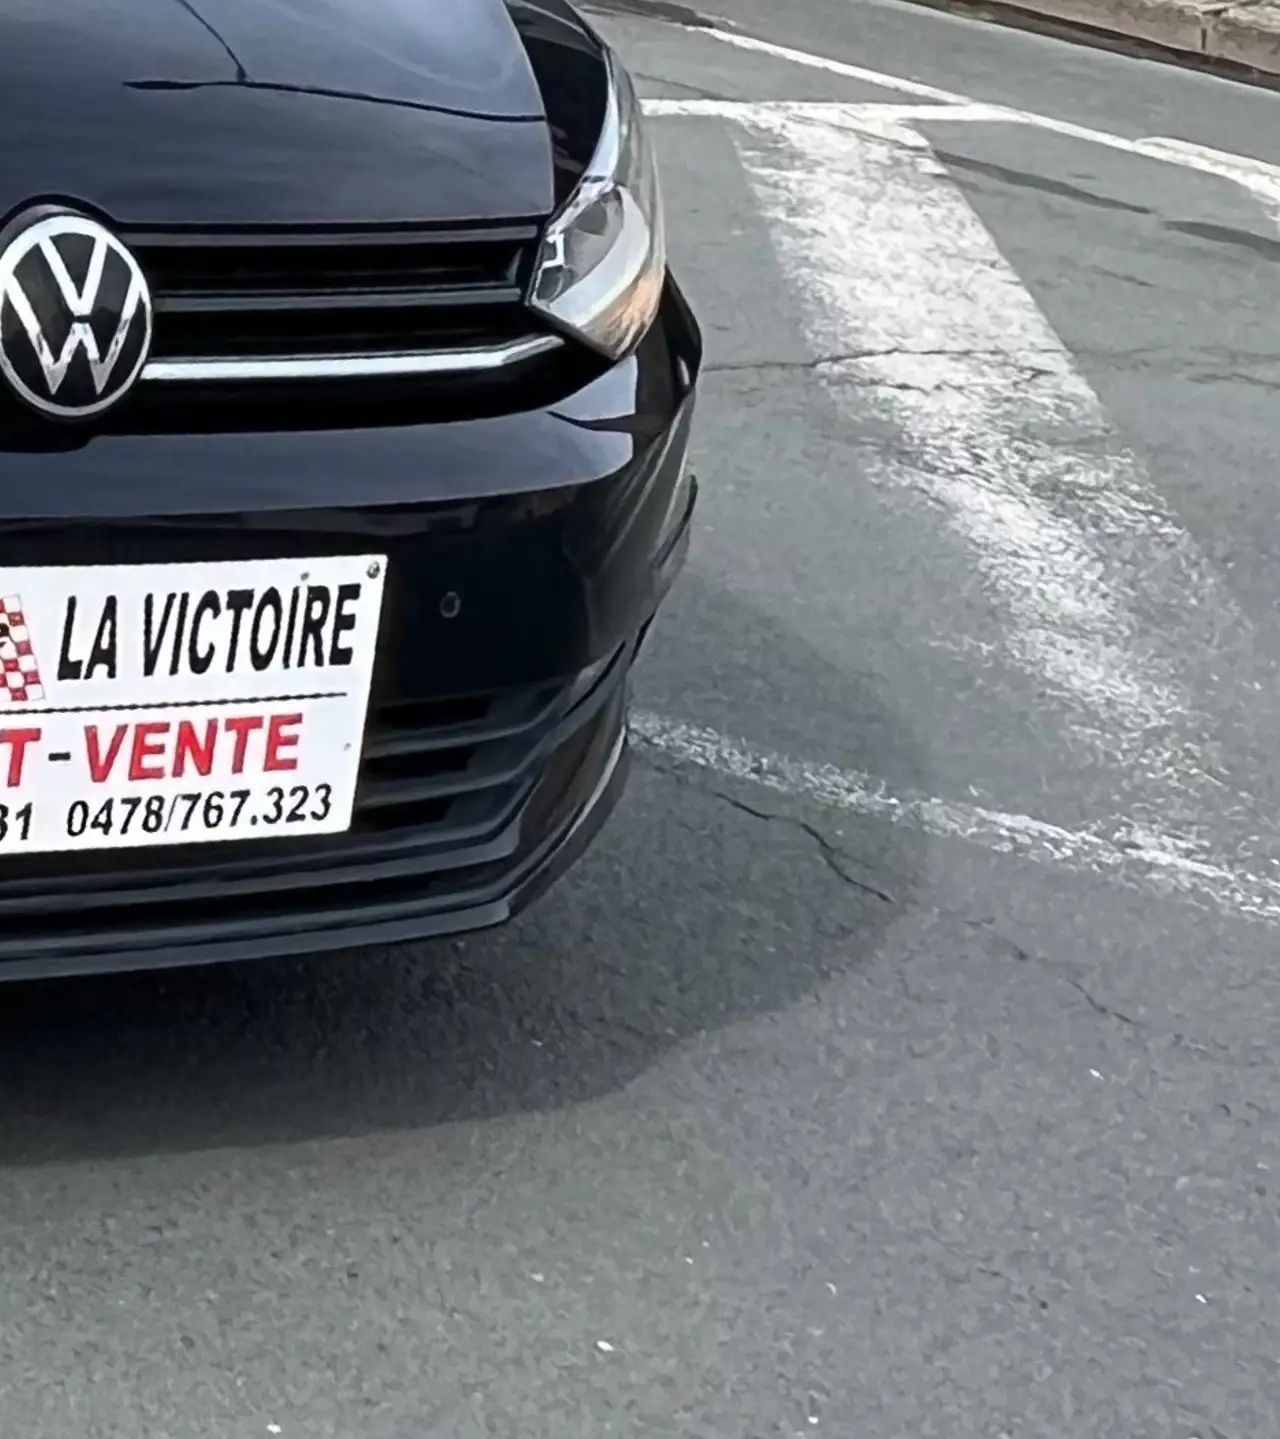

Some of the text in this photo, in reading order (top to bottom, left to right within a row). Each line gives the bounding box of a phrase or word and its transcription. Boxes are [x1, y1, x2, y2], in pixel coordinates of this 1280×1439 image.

[57, 595, 117, 680] LA
[143, 583, 362, 677] VICTOIRE
[66, 783, 332, 837] 0478/767.323
